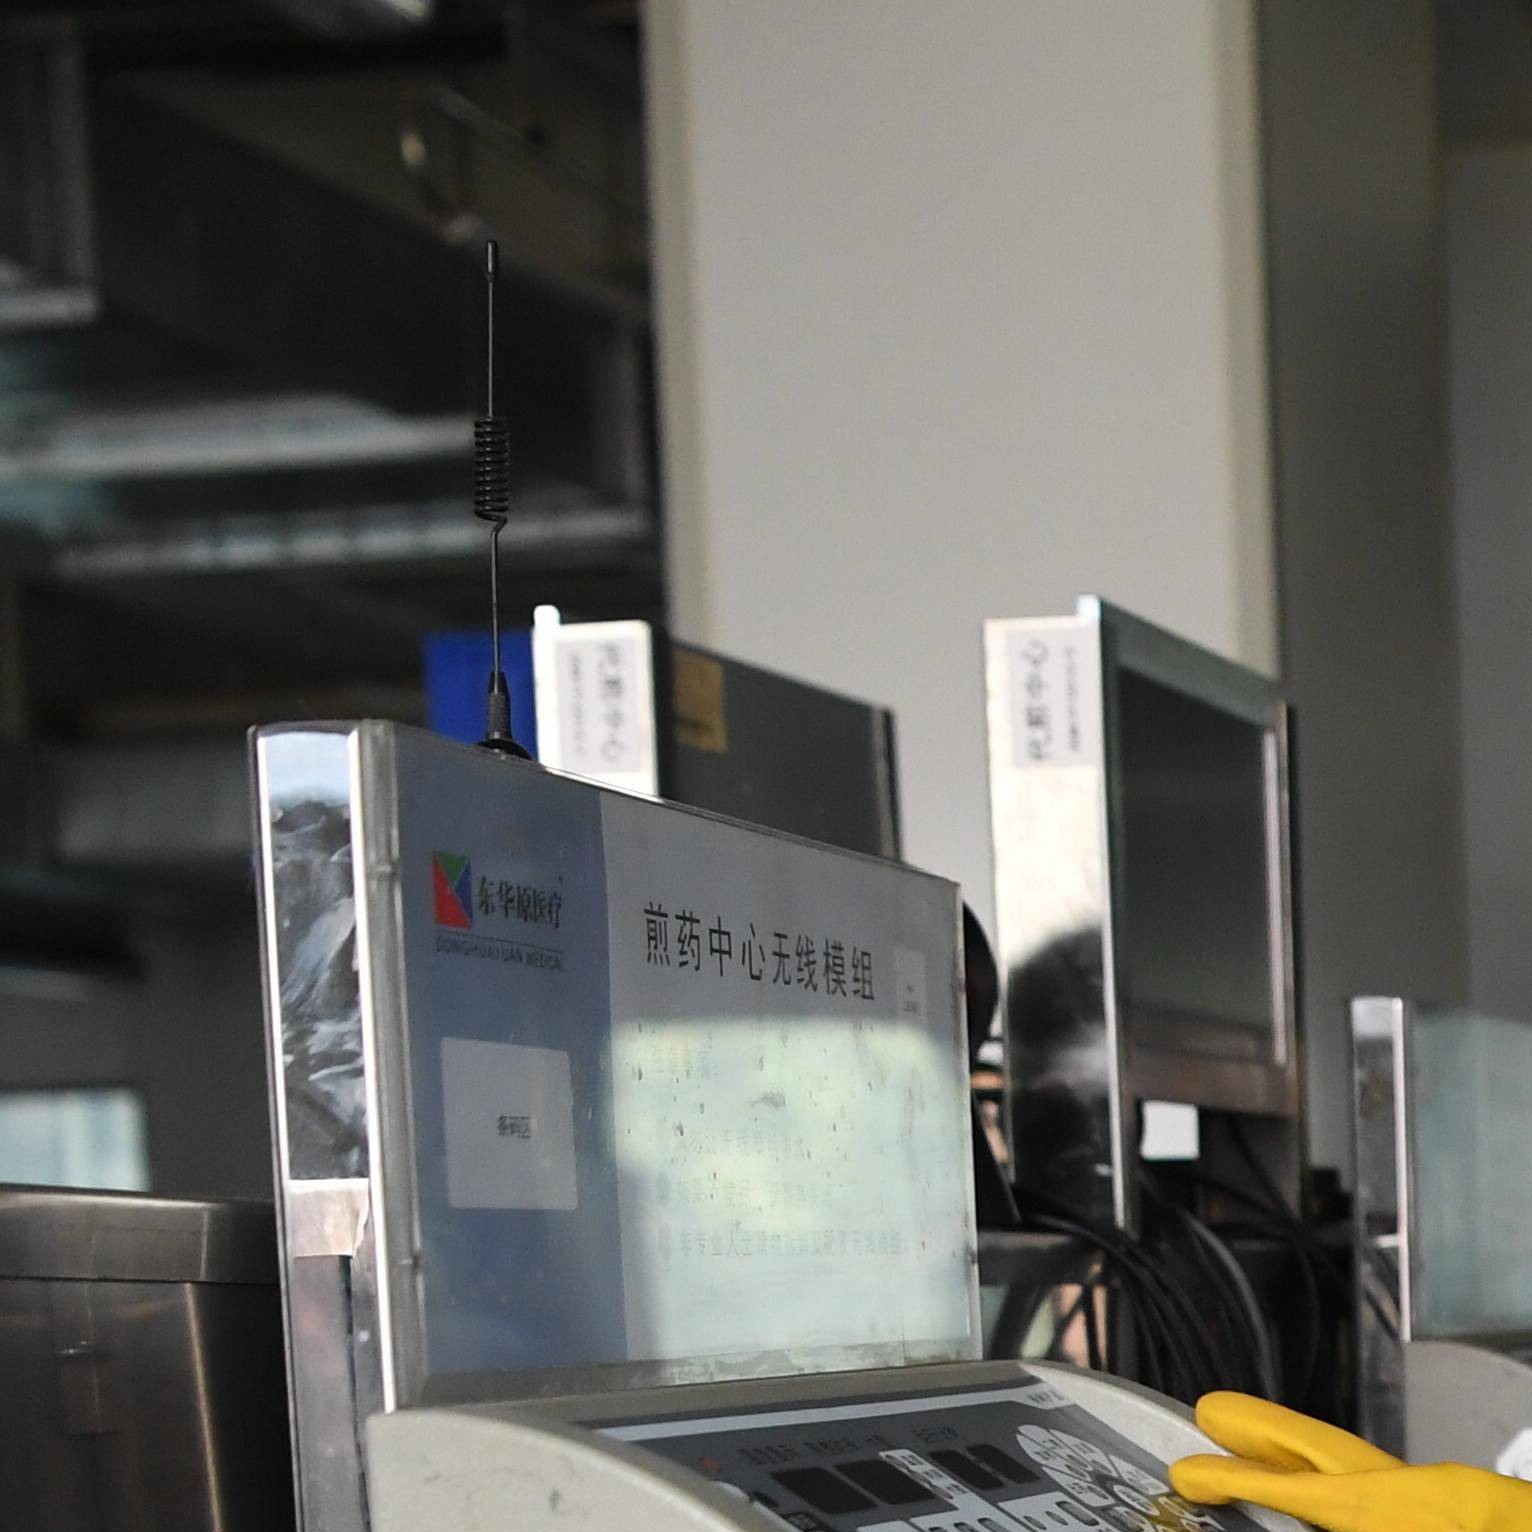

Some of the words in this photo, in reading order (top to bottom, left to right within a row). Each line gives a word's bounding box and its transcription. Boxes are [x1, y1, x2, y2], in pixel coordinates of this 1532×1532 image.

[643, 901, 876, 1001] 煎药中心无线模组
